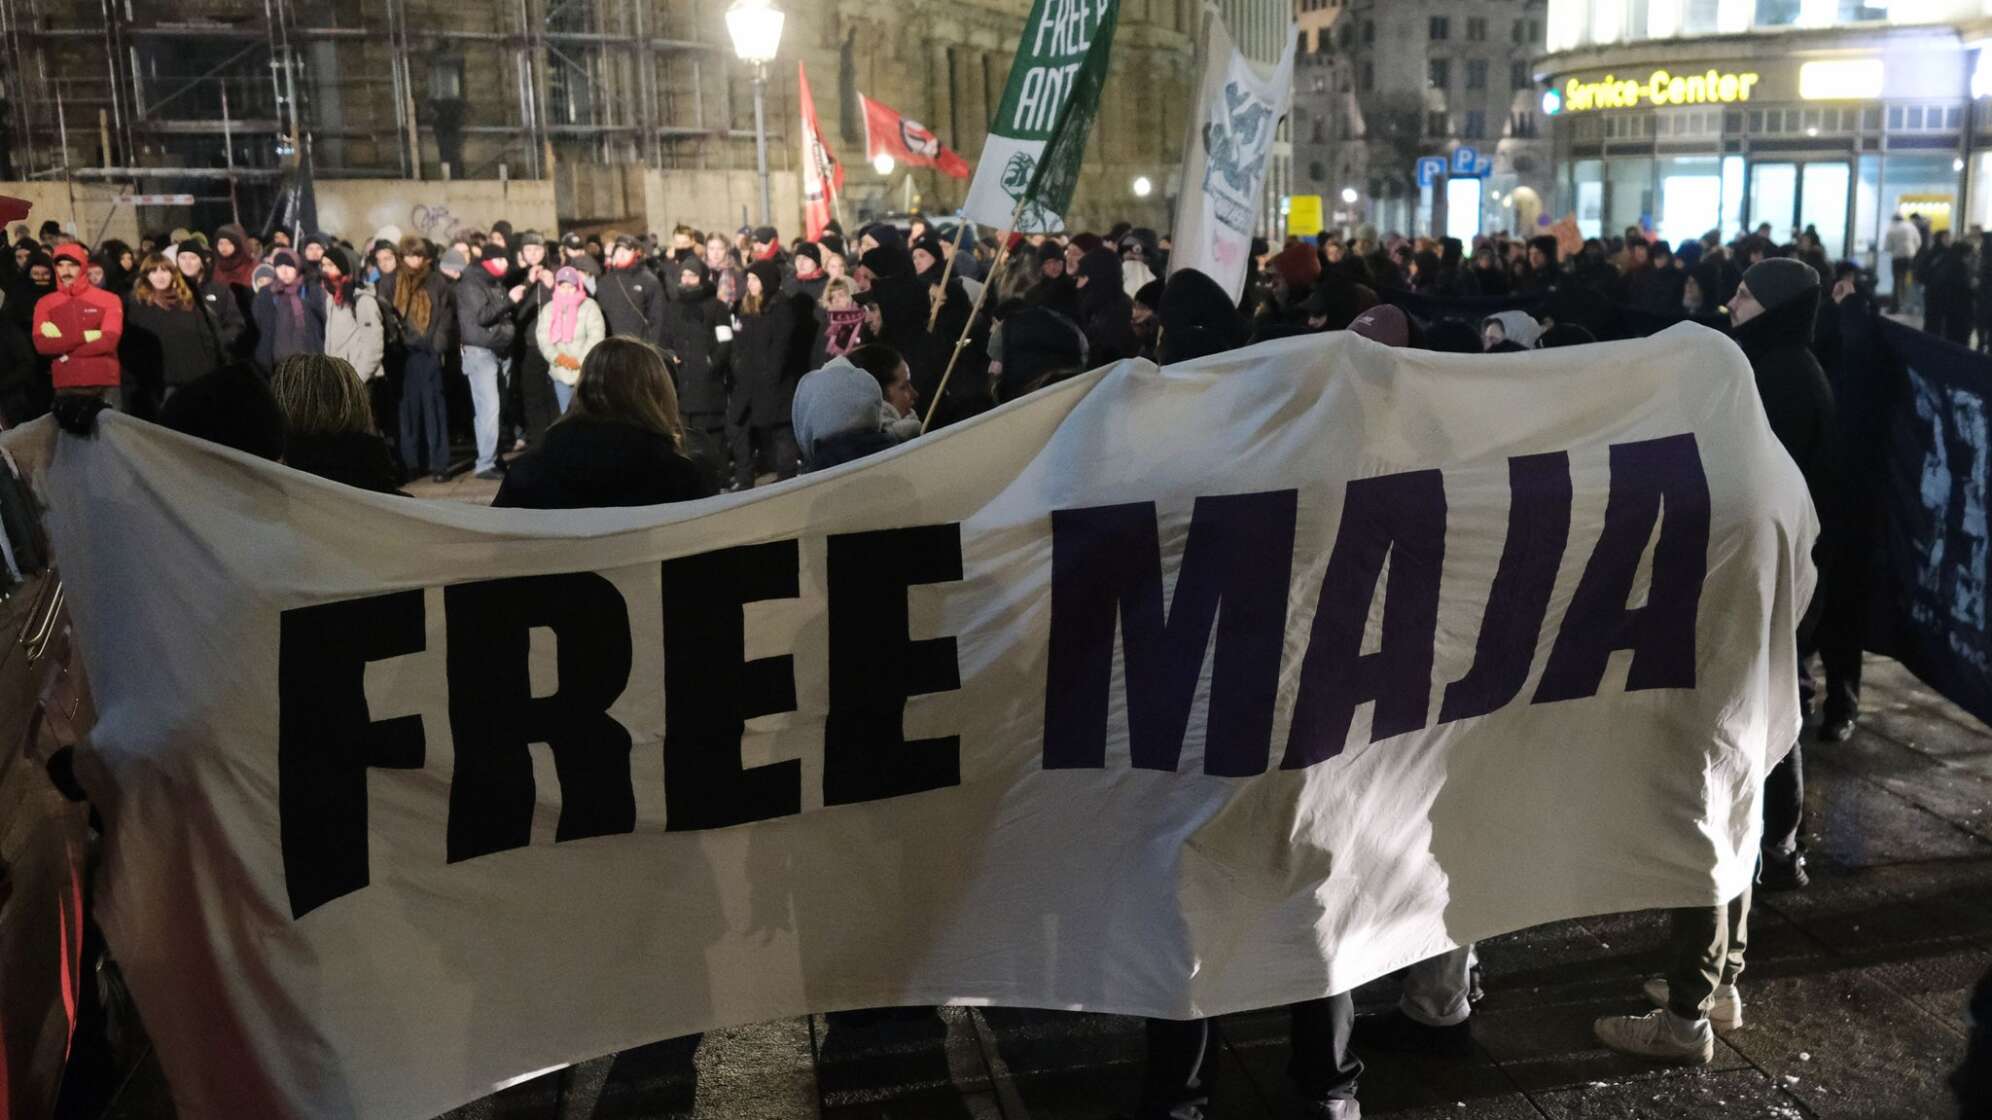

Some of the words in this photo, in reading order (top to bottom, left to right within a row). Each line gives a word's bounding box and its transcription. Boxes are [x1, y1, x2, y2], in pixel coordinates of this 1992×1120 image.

[1032, 0, 1091, 57] FREE
[1013, 62, 1082, 132] ANT
[1566, 68, 1759, 111] Service-Center
[1423, 160, 1439, 183] P
[1456, 149, 1473, 169] P
[278, 522, 963, 920] FREE
[1042, 433, 1711, 777] MAJA
